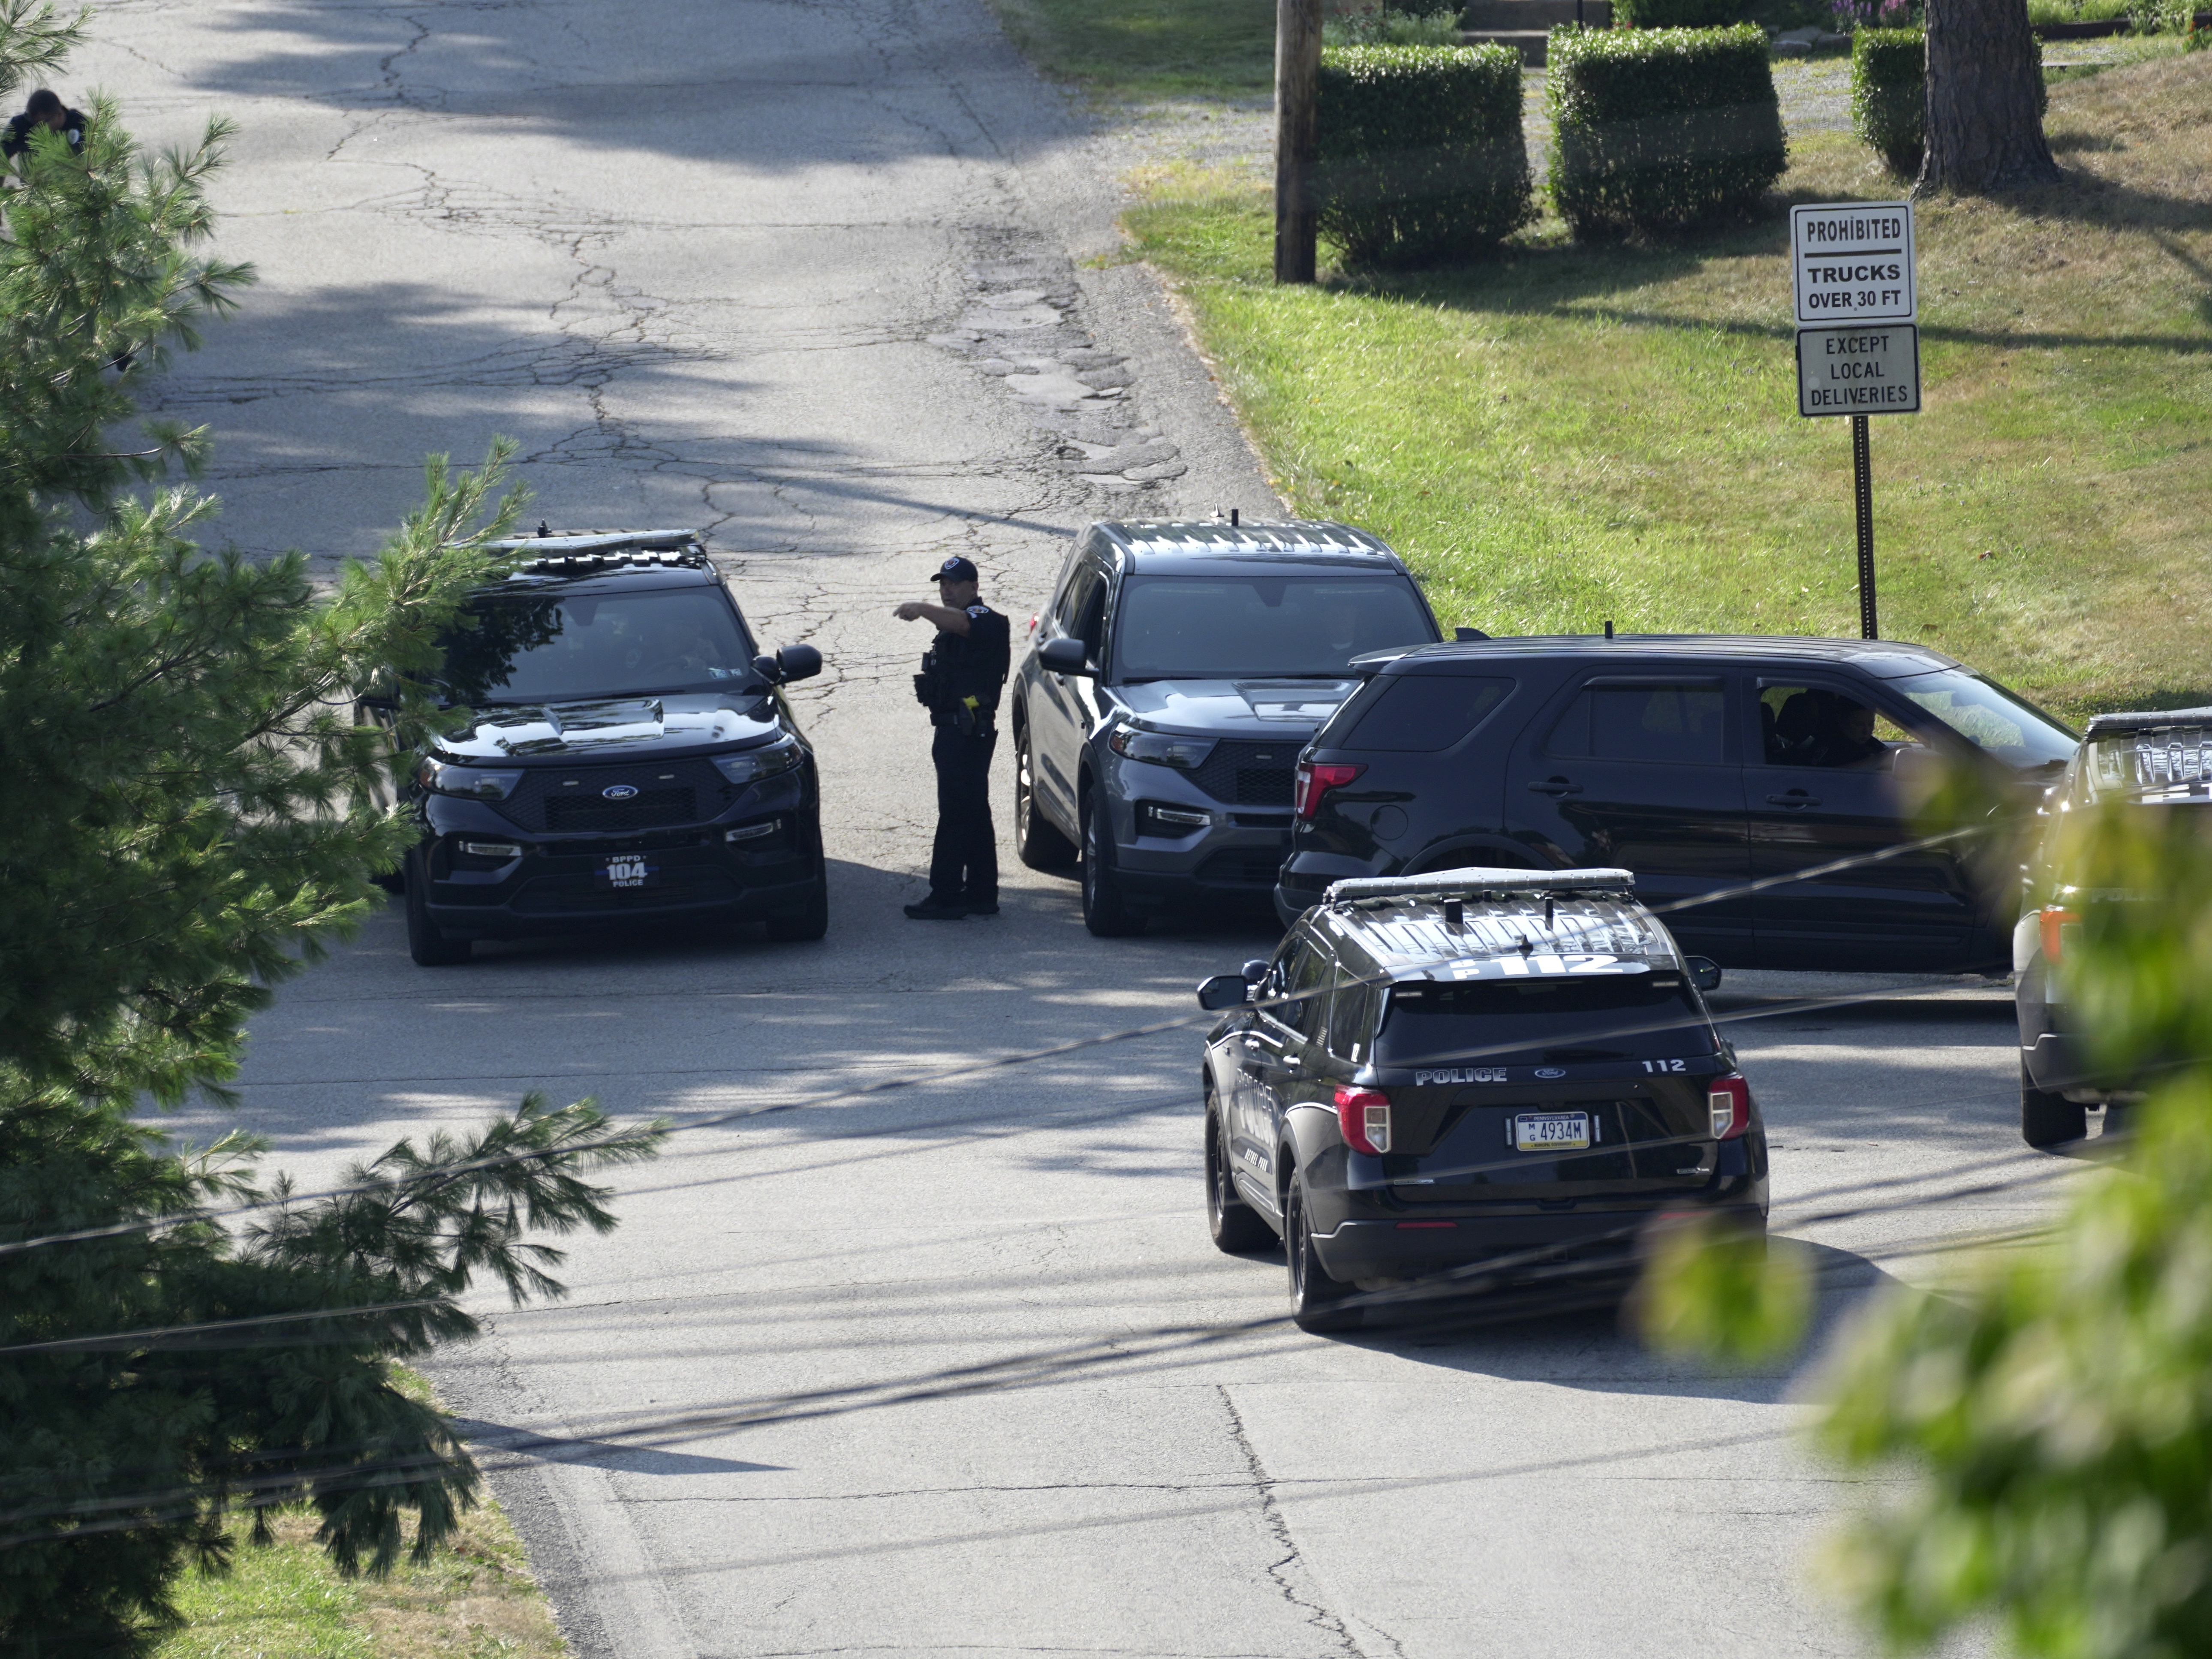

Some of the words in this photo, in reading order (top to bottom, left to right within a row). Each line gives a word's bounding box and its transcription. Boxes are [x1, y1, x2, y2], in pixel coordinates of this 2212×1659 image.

[1807, 218, 1901, 242] PROHIBITED
[1808, 264, 1900, 283] TRUCKS
[1809, 292, 1852, 308] OVER
[1857, 291, 1876, 306] 30
[1882, 290, 1901, 306] FT
[1826, 336, 1889, 355] EXCEPT
[1831, 362, 1884, 379] LOCAL
[1812, 385, 1908, 406] DELIVERIES
[607, 862, 648, 881] 104
[613, 879, 644, 888] POLICE
[1452, 968, 1480, 980] P
[1490, 954, 1624, 976] 112
[1642, 1059, 1686, 1072] 112
[1416, 1068, 1507, 1086] POLICE
[1541, 1122, 1582, 1141] 4934M
